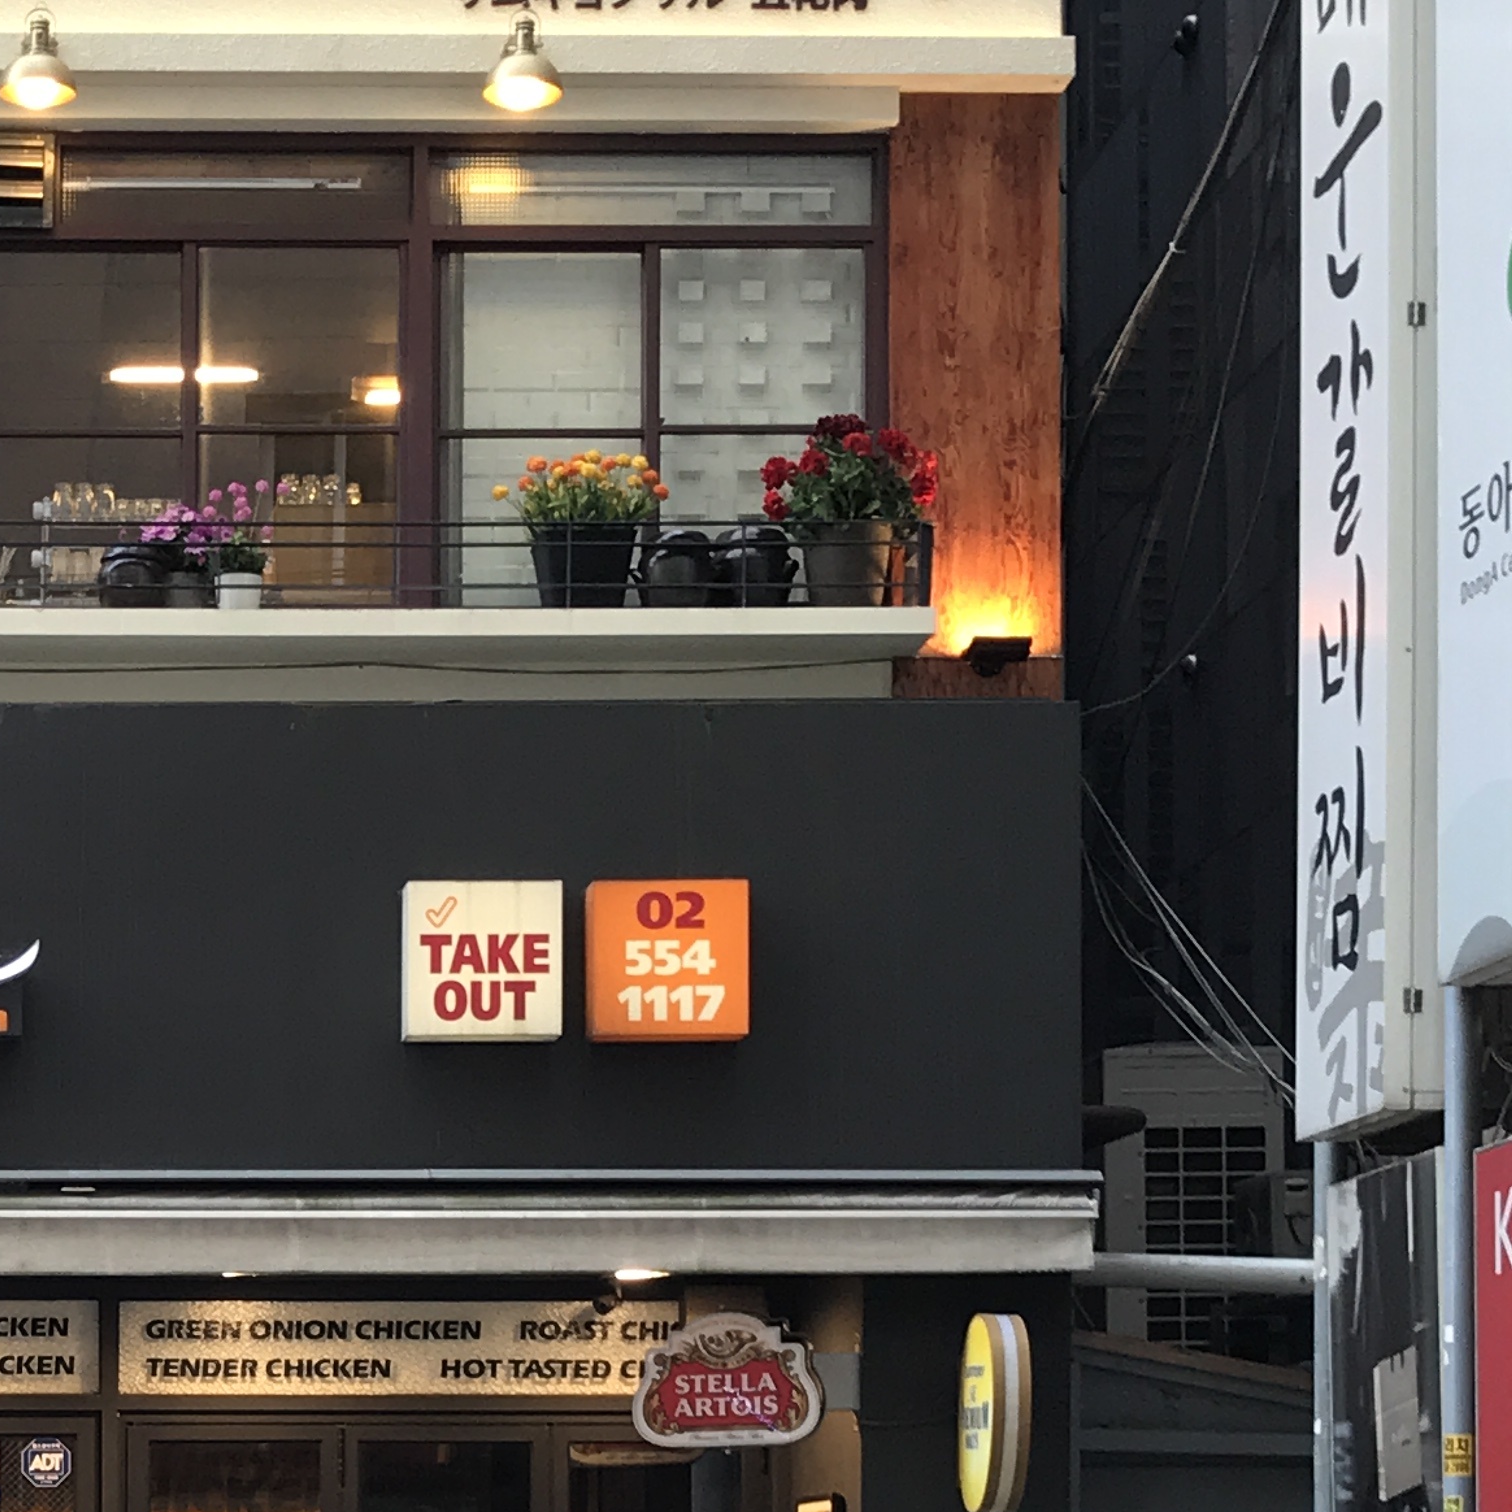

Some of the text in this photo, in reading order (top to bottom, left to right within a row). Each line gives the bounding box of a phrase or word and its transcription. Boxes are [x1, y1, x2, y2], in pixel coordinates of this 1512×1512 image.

[636, 891, 706, 929] 02
[420, 934, 550, 975] TAKE
[624, 939, 716, 976] 554
[433, 980, 536, 1021] OUT
[617, 984, 726, 1022] 1117
[145, 1319, 242, 1341] GREEN
[249, 1319, 350, 1341] ONION
[355, 1319, 481, 1341] CHICKEN
[518, 1319, 613, 1341] ROAST
[145, 1357, 258, 1379] TENDER
[266, 1357, 391, 1379] CHICKEN
[440, 1357, 502, 1379] HOT
[508, 1357, 612, 1379] TASTED
[674, 1372, 777, 1395] STELLA
[674, 1395, 779, 1418] ARTOIS
[29, 1453, 64, 1471] ADT
